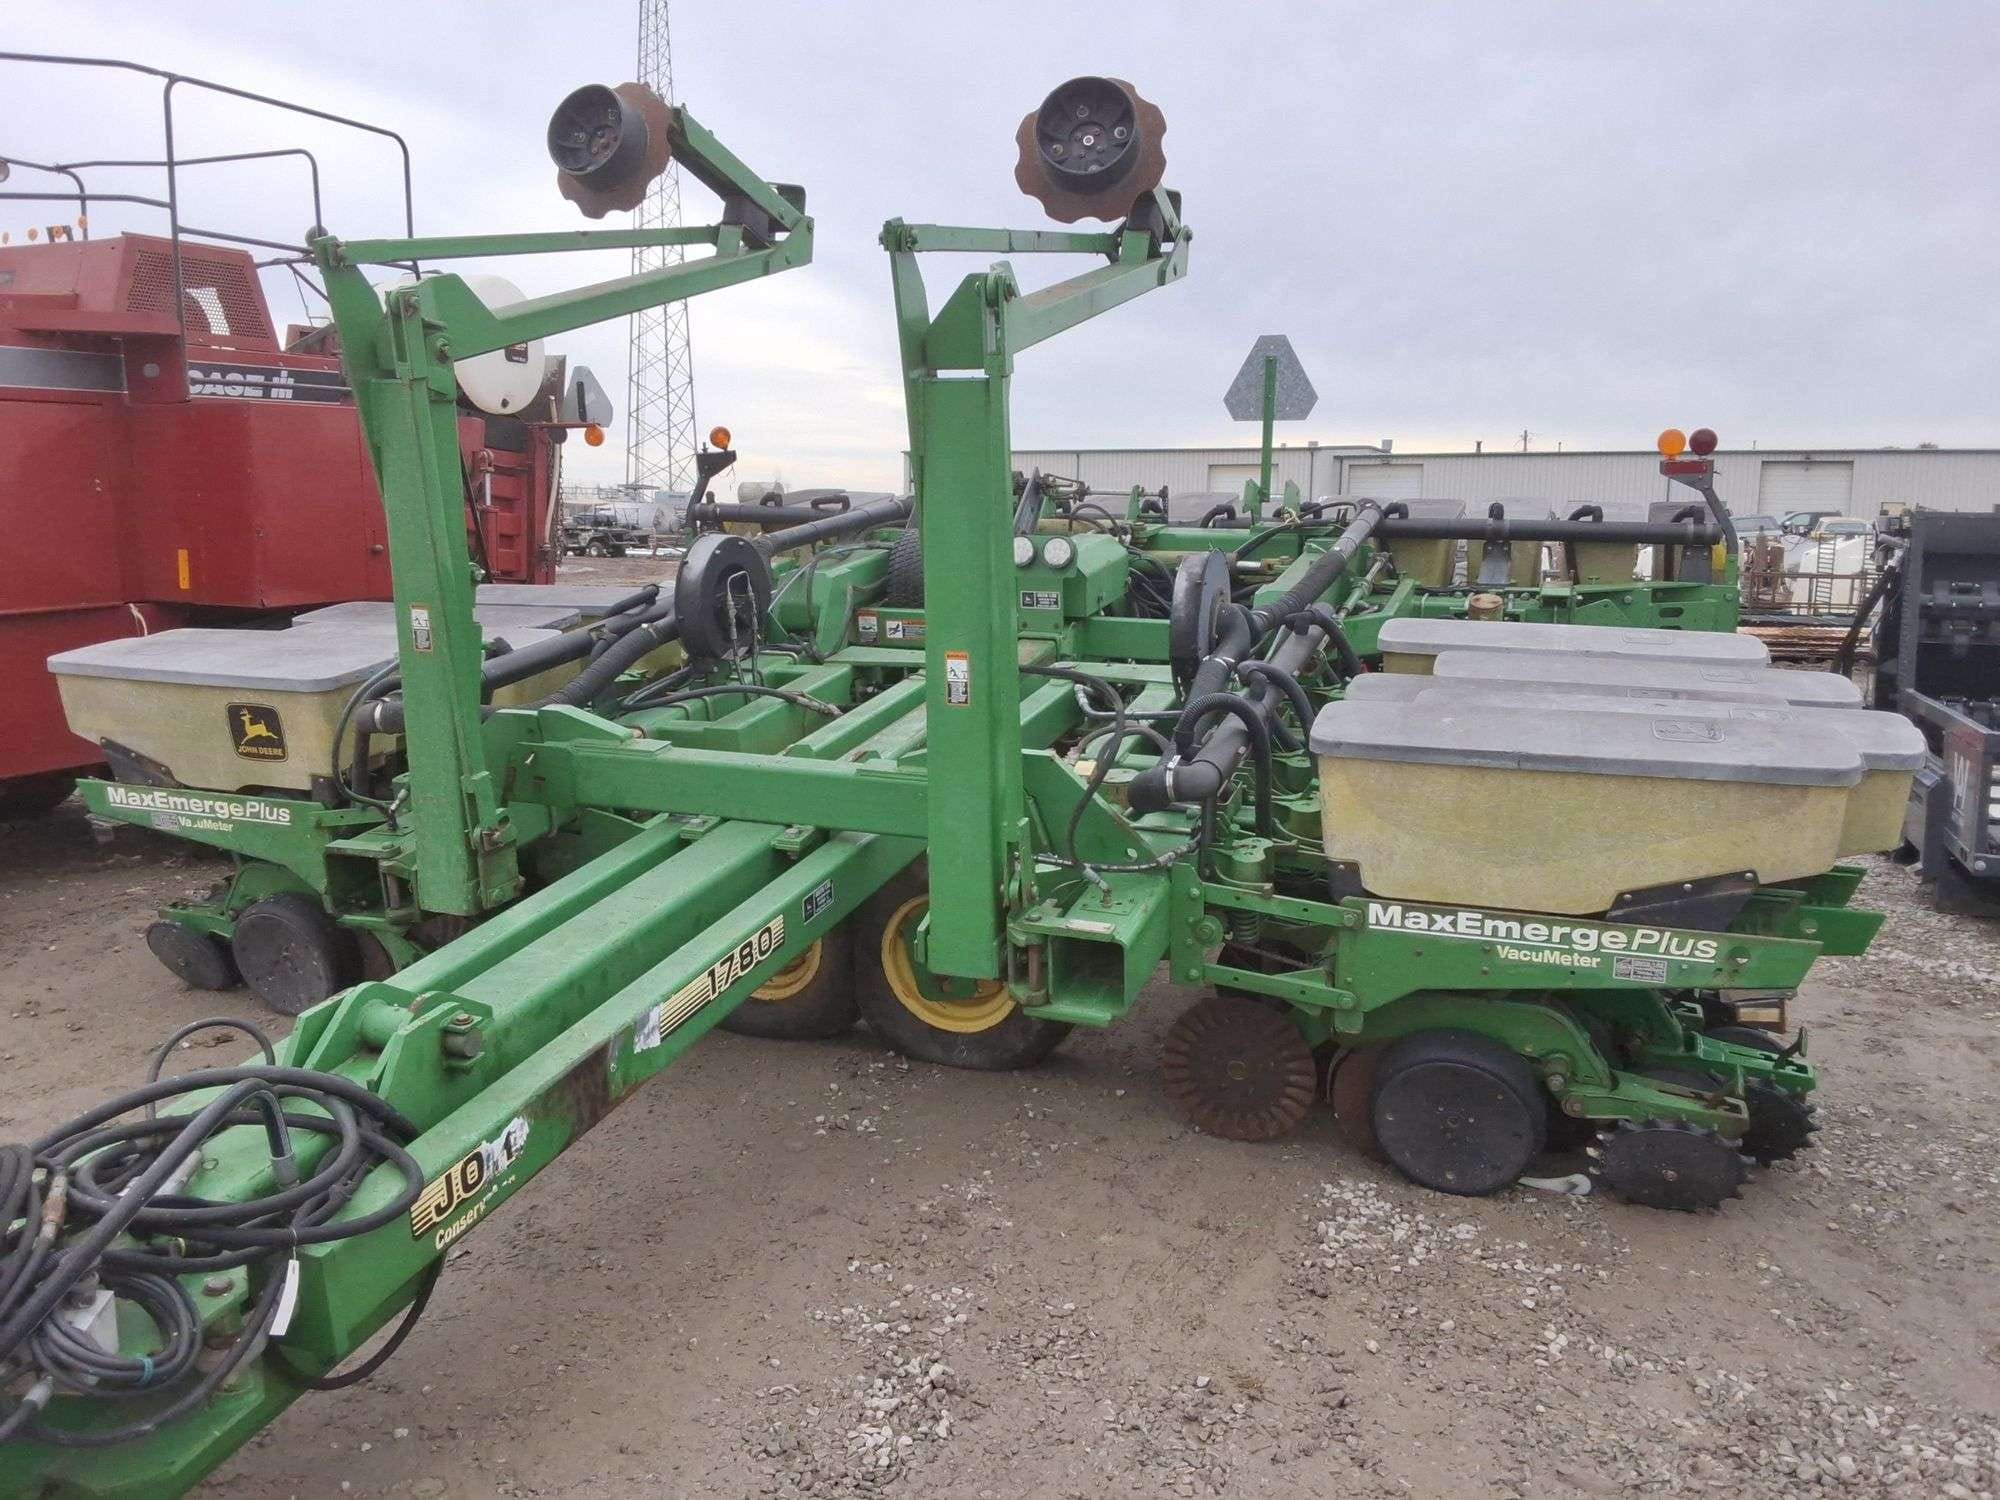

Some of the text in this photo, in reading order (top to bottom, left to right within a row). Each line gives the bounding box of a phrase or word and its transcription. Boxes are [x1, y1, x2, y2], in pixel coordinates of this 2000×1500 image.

[238, 745, 284, 756] JOHN DEERE
[707, 926, 772, 996] 1780
[1496, 945, 1602, 969] VacuMeter
